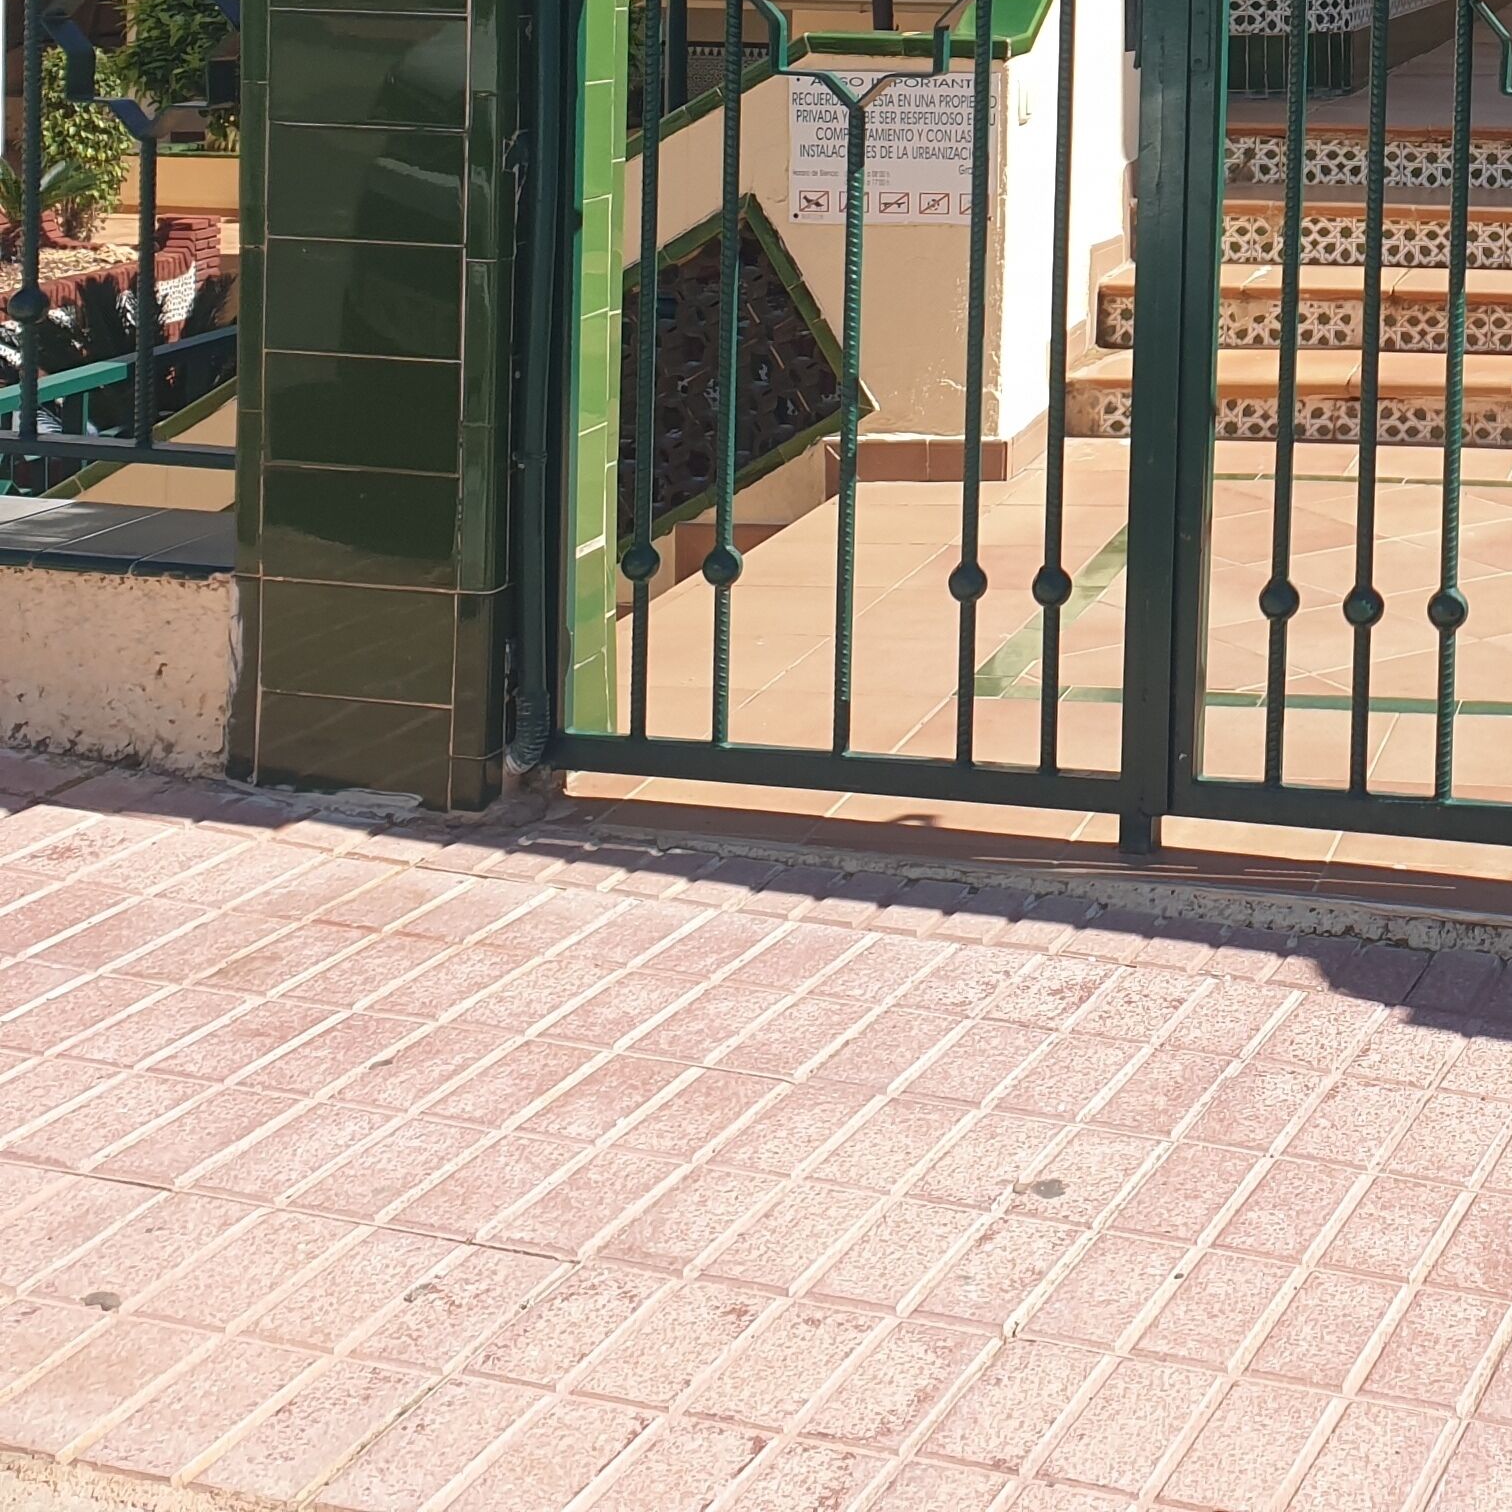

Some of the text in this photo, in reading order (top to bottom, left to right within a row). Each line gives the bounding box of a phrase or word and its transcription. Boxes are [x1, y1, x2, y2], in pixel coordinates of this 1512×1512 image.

[792, 91, 845, 106] RECUERD
[898, 93, 911, 107] EN
[914, 94, 936, 108] UNA
[939, 94, 997, 108] PROPIED
[796, 109, 839, 123] PRIVADA
[841, 110, 848, 123] Y
[879, 110, 897, 124] SER
[900, 111, 964, 125] RESPETUOSO
[815, 126, 972, 143] COMPTAMIENTO Y CON LAS
[880, 145, 893, 159] DE
[897, 146, 909, 159] LA
[912, 146, 972, 160] URBANIZACI
